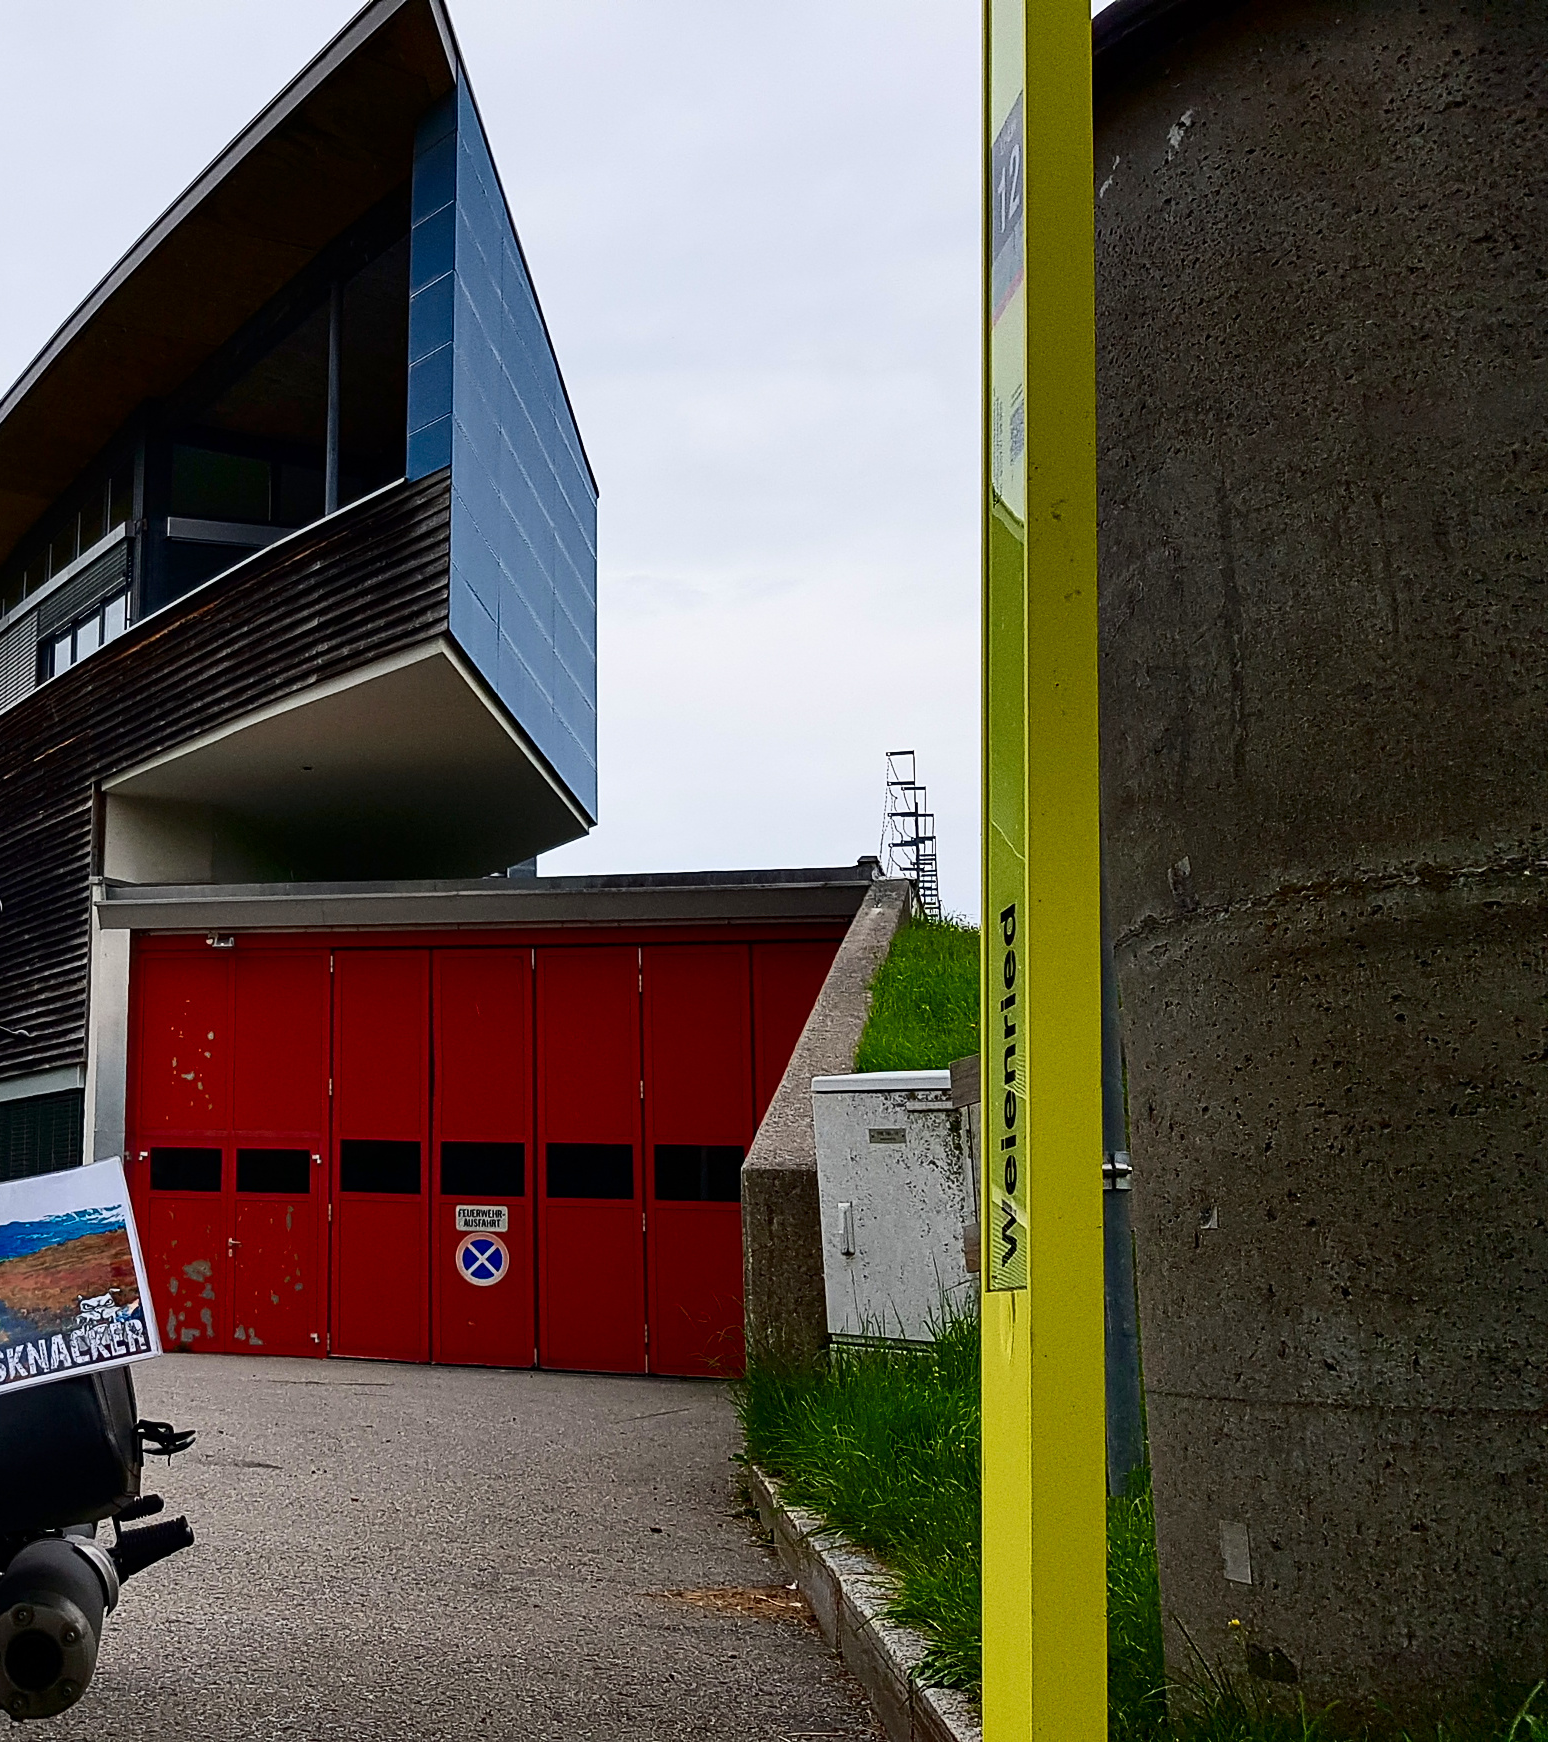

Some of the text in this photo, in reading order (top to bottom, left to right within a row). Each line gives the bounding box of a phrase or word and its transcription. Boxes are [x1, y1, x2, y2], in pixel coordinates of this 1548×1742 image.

[998, 143, 1020, 233] 12
[1001, 903, 1018, 1268] Weienried
[458, 1209, 506, 1219] FEUERWEHR-
[463, 1218, 501, 1228] AUSFAHRT
